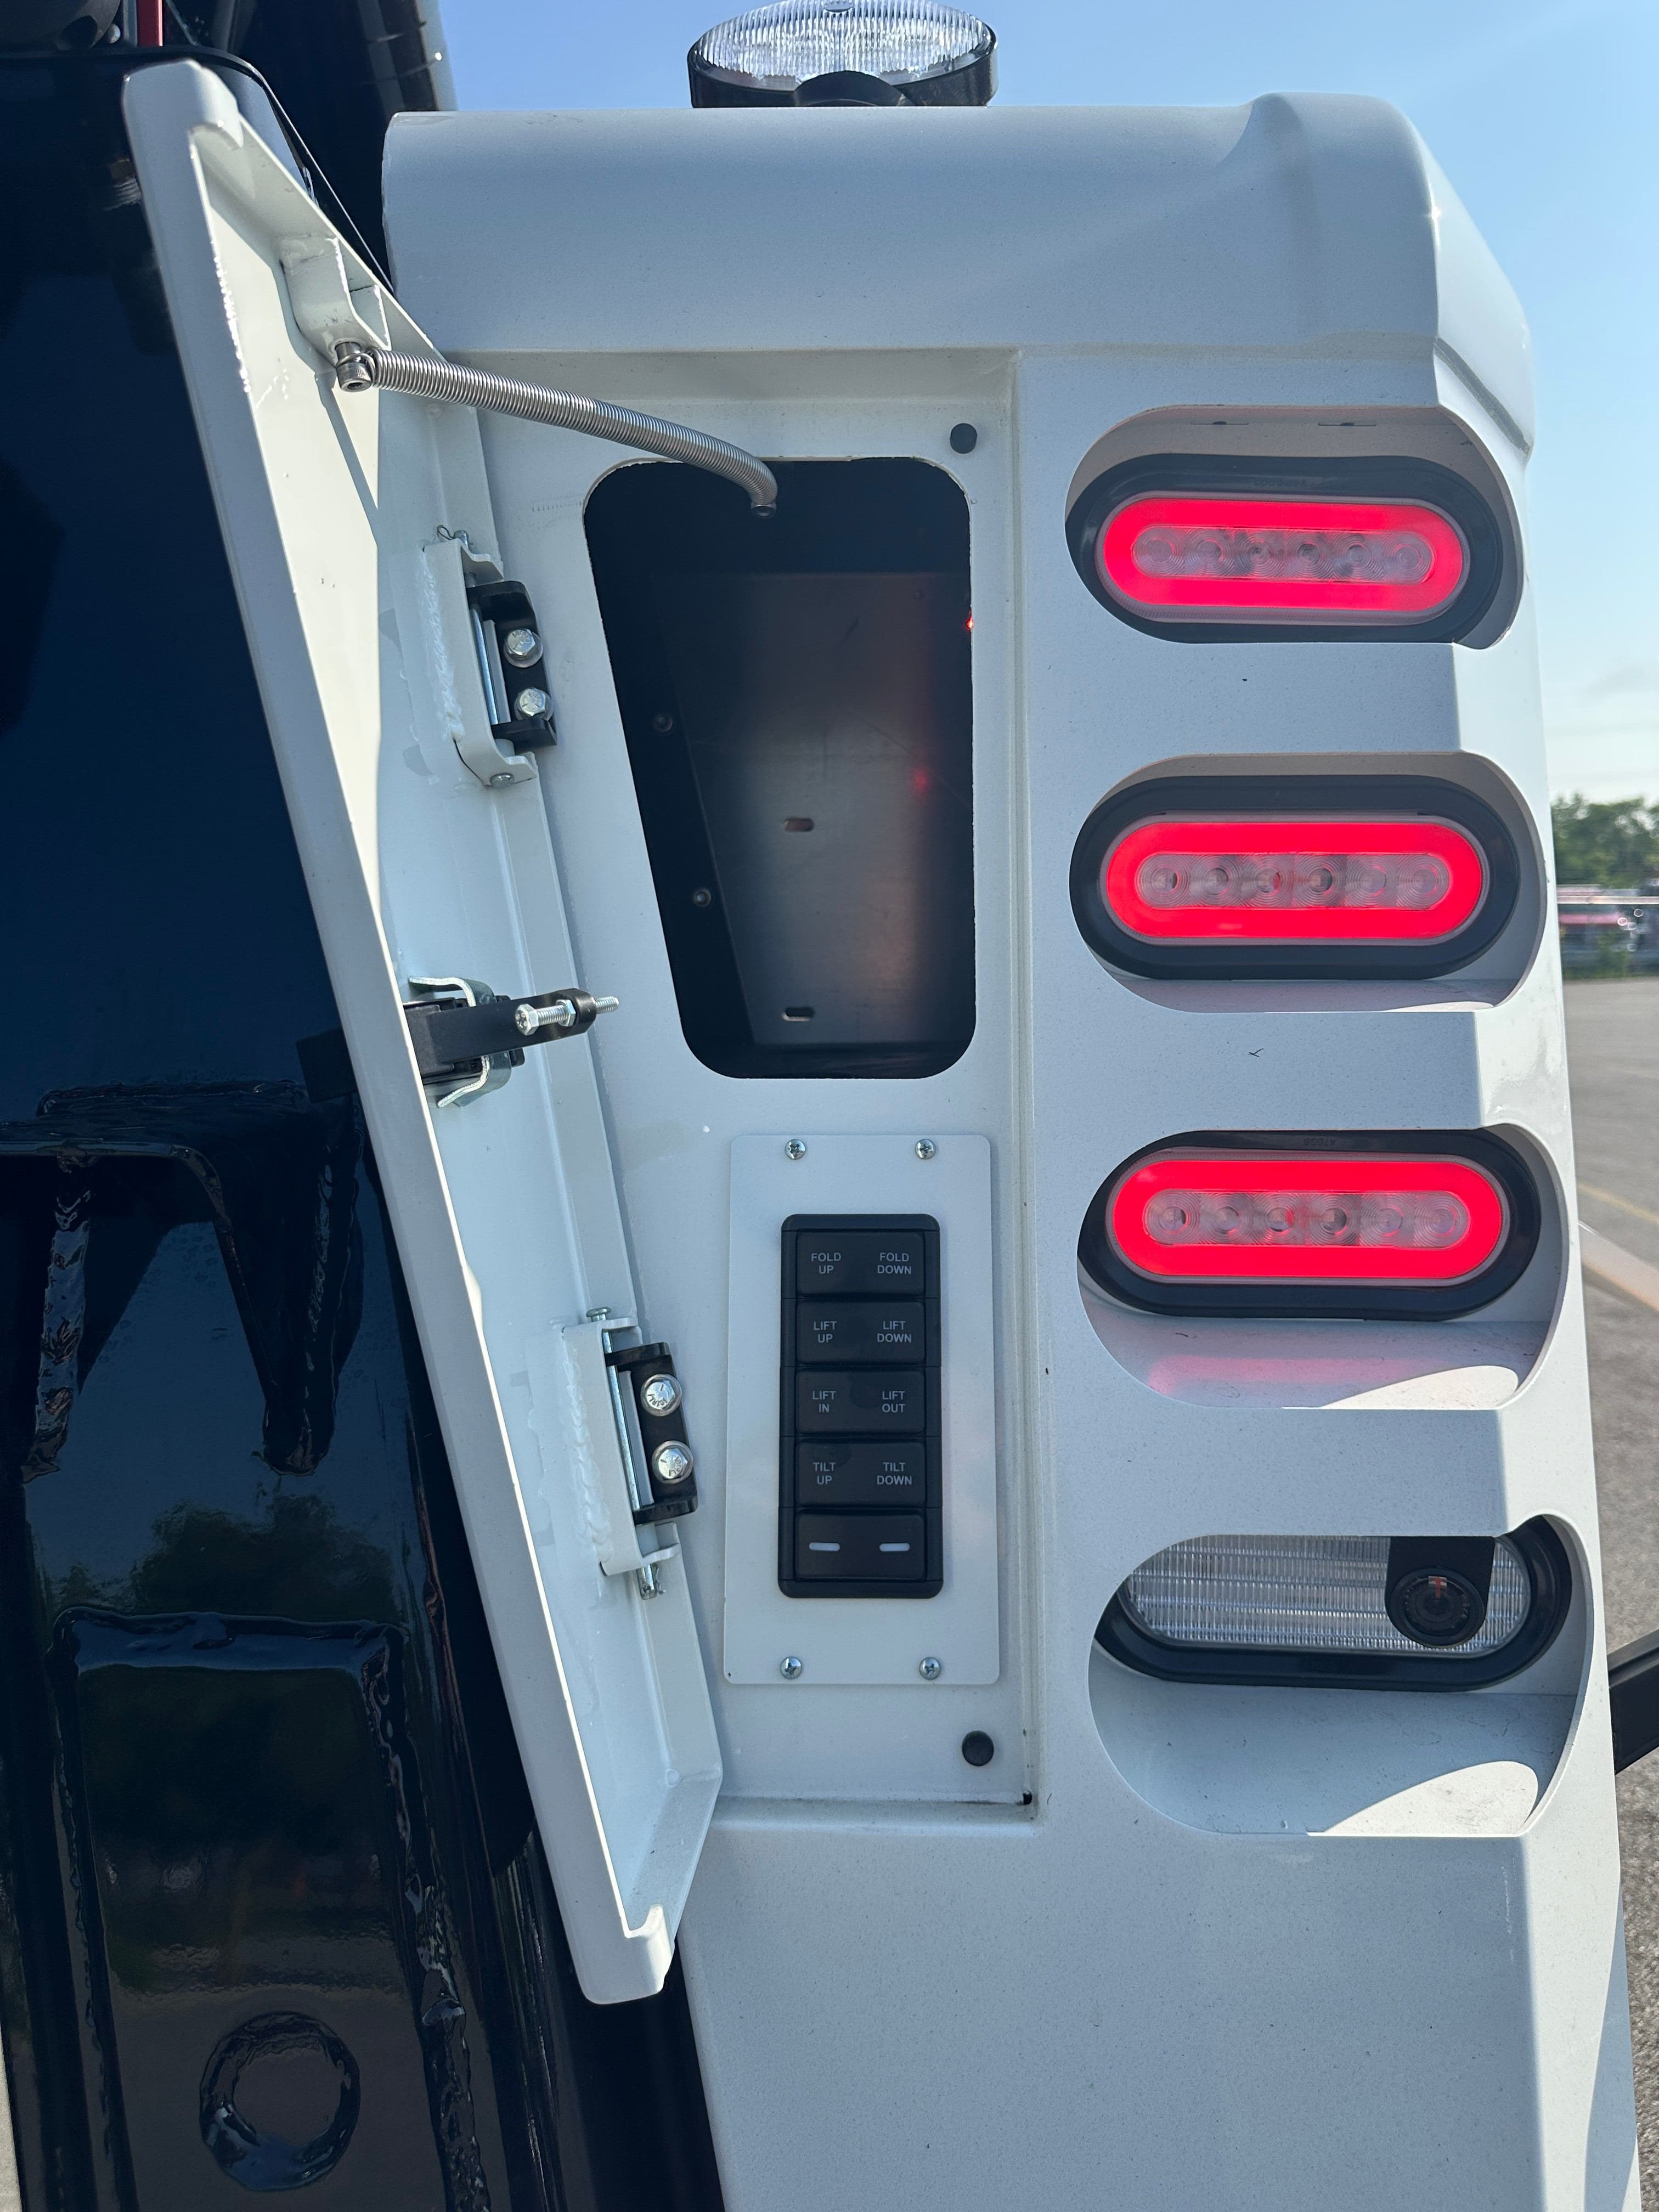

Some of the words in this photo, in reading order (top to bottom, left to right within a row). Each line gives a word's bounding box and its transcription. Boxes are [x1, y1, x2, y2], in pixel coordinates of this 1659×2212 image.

[811, 1252, 842, 1262] FOLD
[879, 1252, 910, 1262] FOLD
[819, 1265, 834, 1274] UP
[877, 1265, 912, 1274] DOWN
[813, 1321, 837, 1330] LIFT
[882, 1321, 906, 1330] LIFT
[817, 1334, 833, 1344] UP
[877, 1333, 912, 1343] DOWN
[812, 1391, 836, 1400] LIFT
[882, 1390, 905, 1400] LIFT
[819, 1403, 830, 1413] IN
[882, 1403, 906, 1413] OUT
[812, 1462, 836, 1472] TILT
[883, 1462, 906, 1472] TILT
[817, 1475, 832, 1485] UP
[877, 1475, 912, 1485] DOWN
